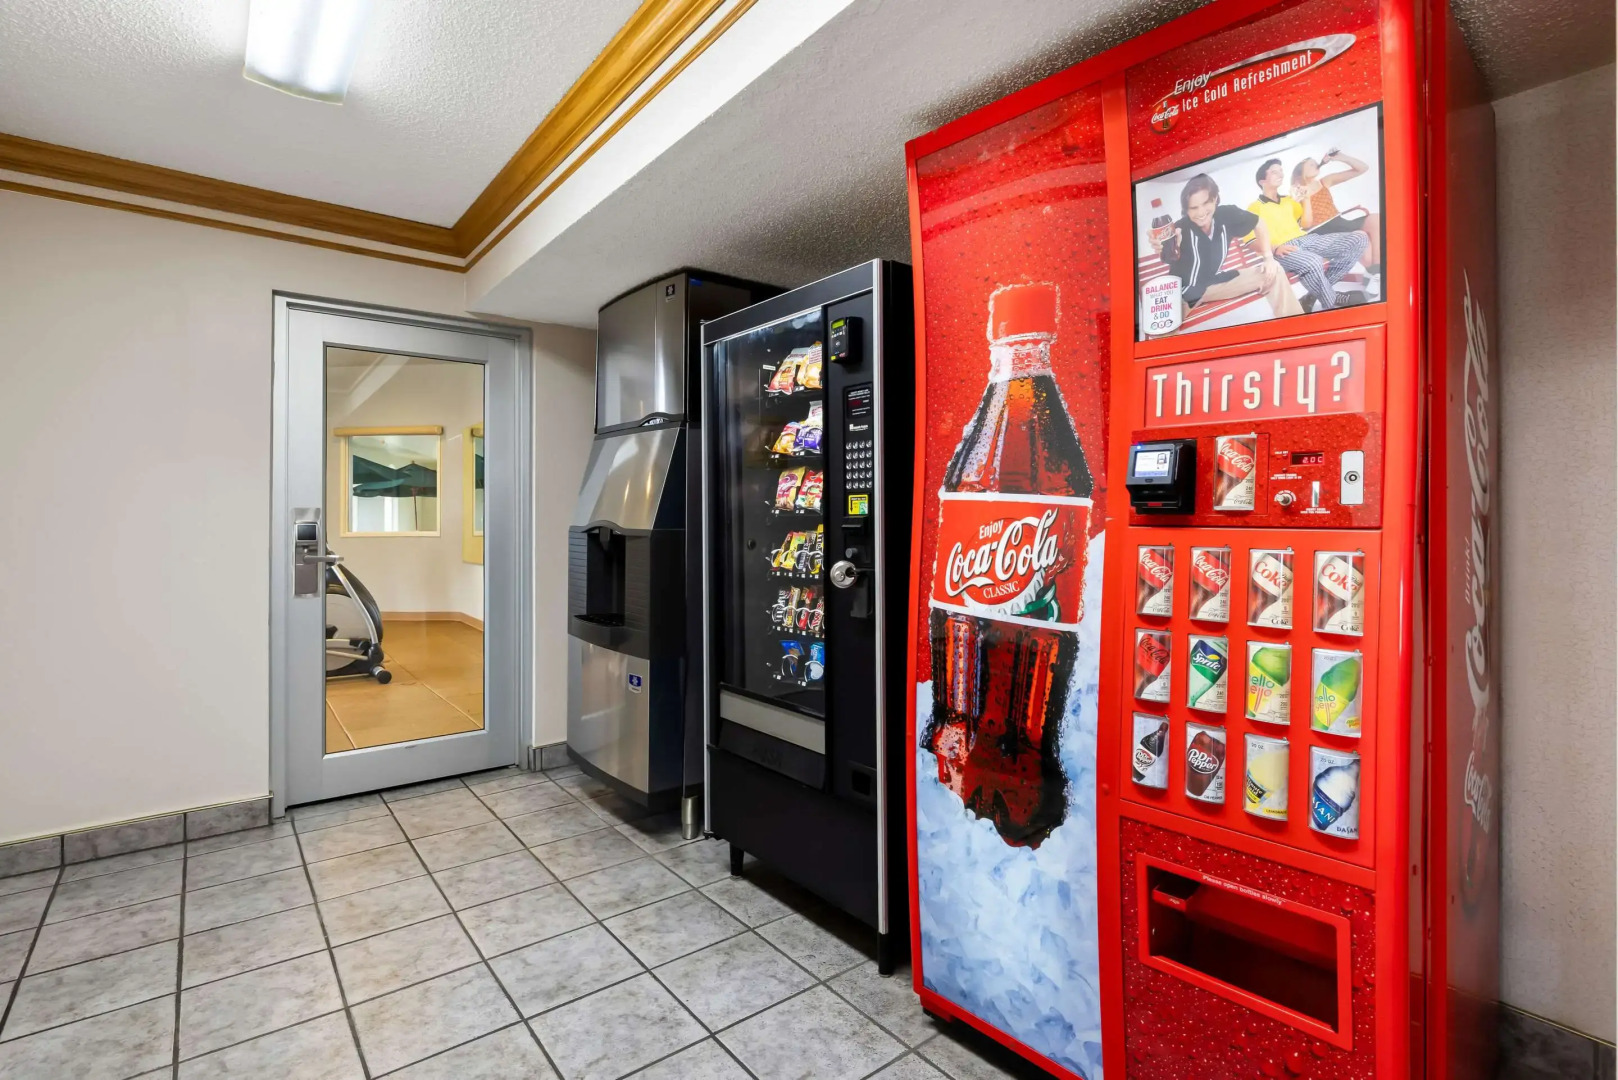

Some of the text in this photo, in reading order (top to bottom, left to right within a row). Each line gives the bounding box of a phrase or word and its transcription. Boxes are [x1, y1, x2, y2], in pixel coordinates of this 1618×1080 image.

[1174, 71, 1212, 95] Enjoy
[1182, 50, 1313, 112] Ice Cold Refreshment
[1145, 280, 1178, 295] BALANCE
[1150, 303, 1173, 314] DRINK
[1154, 296, 1168, 305] EAT
[1159, 311, 1170, 319] DO
[1152, 350, 1351, 418] Thirsty?
[979, 519, 1004, 540] Enjoy
[945, 508, 1060, 597] Coca-Cola
[1254, 561, 1288, 590] Coke
[1321, 563, 1360, 592] Coke
[983, 581, 1020, 599] CLASSIC
[1193, 652, 1221, 670] Sprite
[1251, 674, 1275, 689] ello
[1250, 685, 1272, 713] ello
[1188, 748, 1217, 769] Pepper
[1198, 752, 1213, 763] Dr
[1203, 874, 1282, 906] Please open bottles slowly
